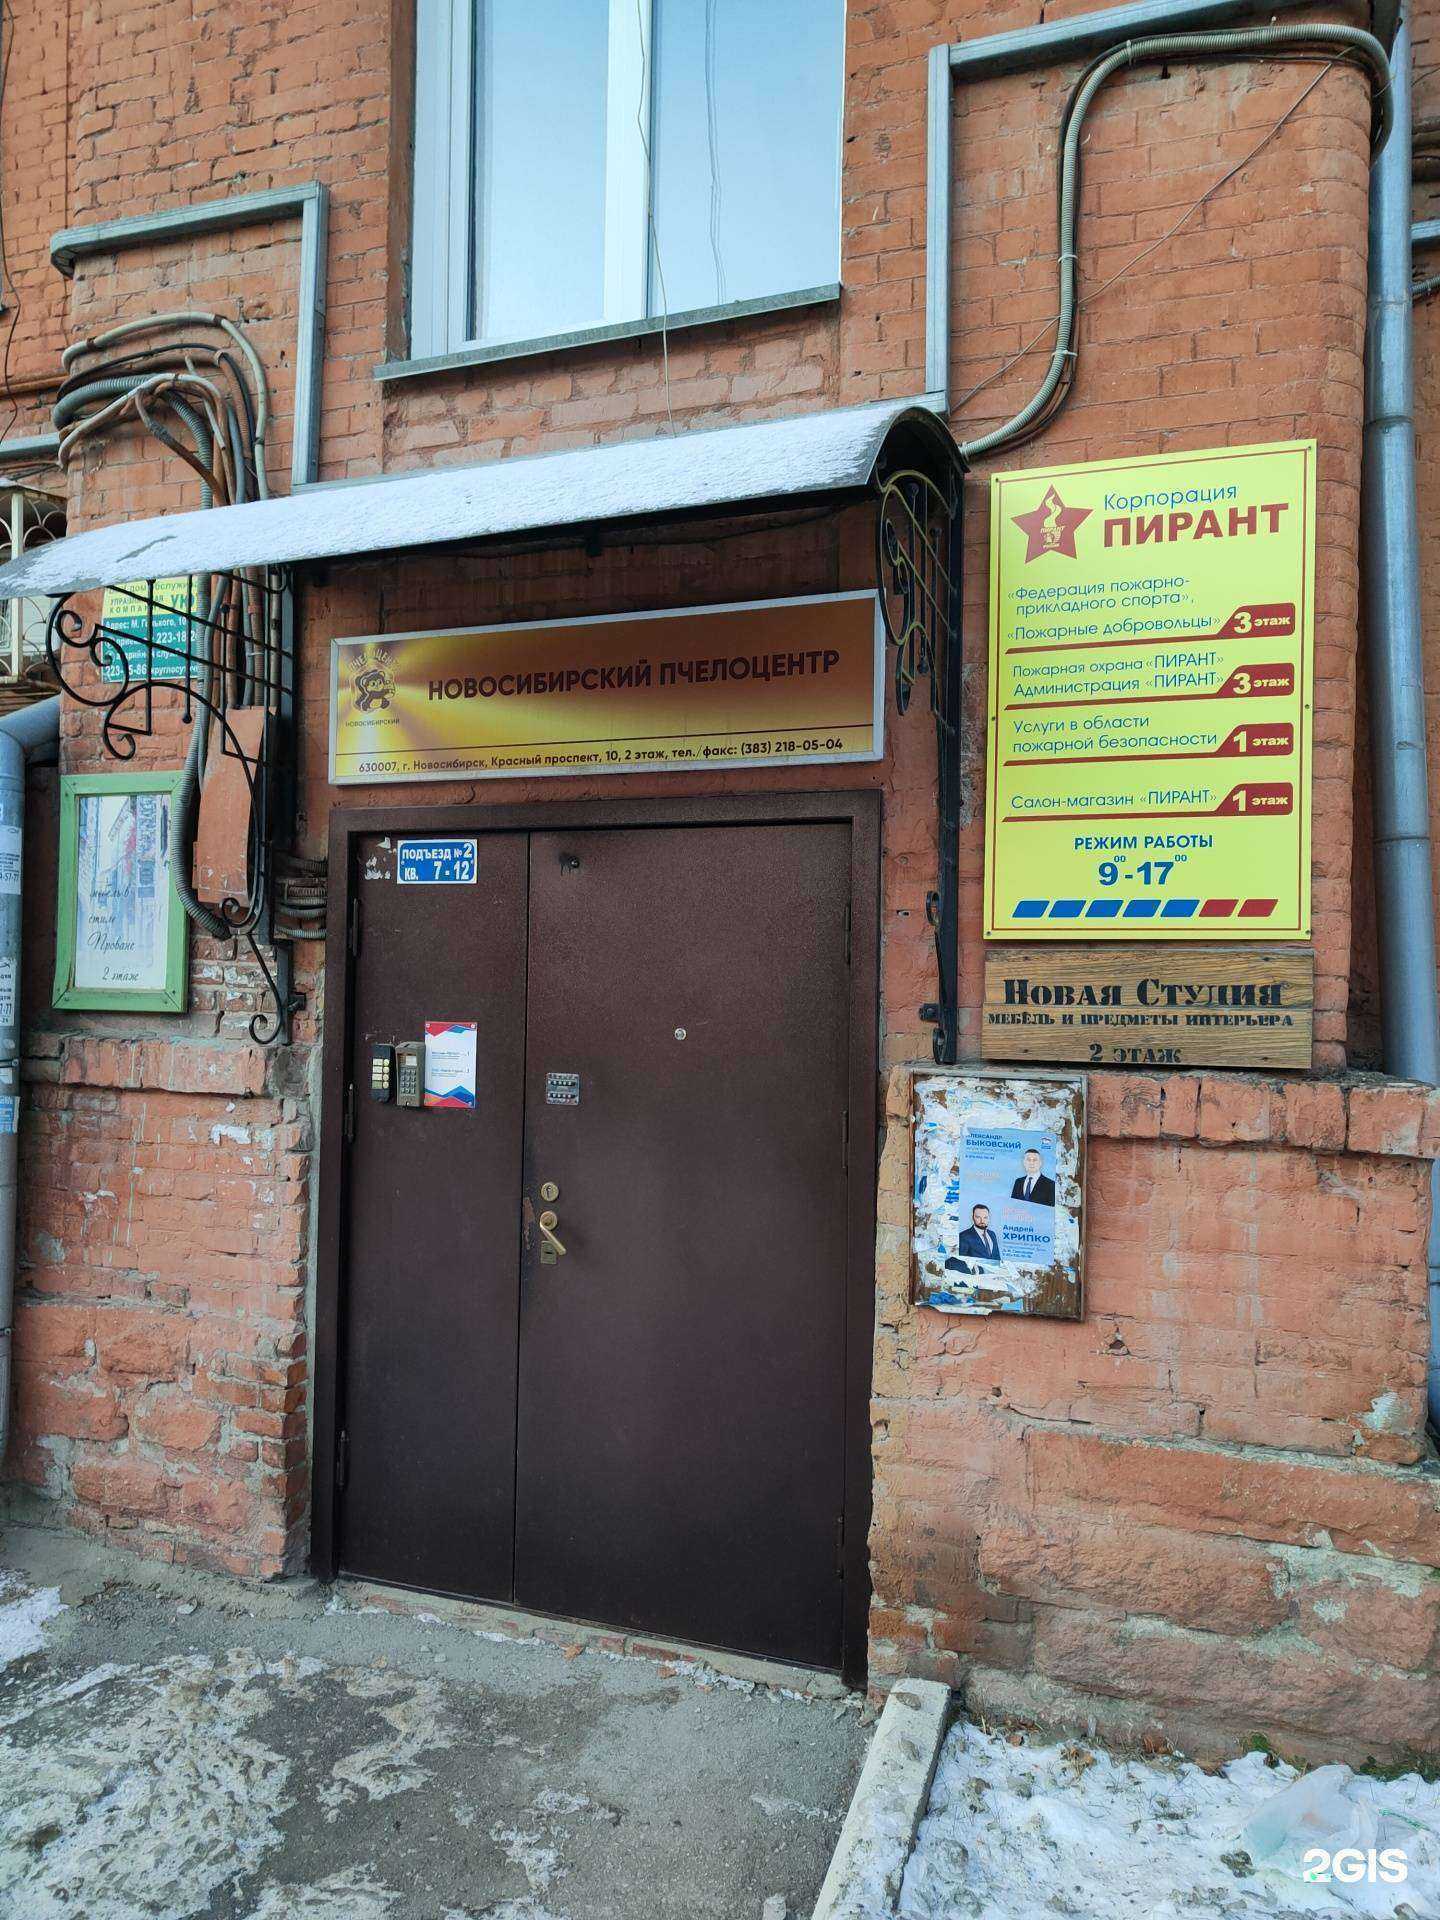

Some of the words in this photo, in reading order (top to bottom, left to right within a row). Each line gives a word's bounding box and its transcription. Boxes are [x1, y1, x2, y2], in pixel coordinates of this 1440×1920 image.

[1104, 486, 1237, 512] Корпорация
[1104, 503, 1289, 548] ПИРАНТ
[1008, 583, 1105, 601] «Федерация
[1110, 576, 1190, 595] пожарно-
[1016, 598, 1115, 618] прикладного
[1008, 624, 1098, 640] «Пожарные
[1103, 616, 1221, 635] добровольцы»
[1233, 611, 1252, 633] 3
[1254, 615, 1291, 627] этаж
[429, 660, 651, 701] НОВОСИБИРСКИЙ
[660, 649, 840, 685] ПЧЕЛОЦЕНТР
[1012, 663, 1085, 678] Пожарная
[1089, 660, 1142, 675] охрана
[1145, 651, 1224, 670] «ПИРАНТ»
[1013, 678, 1140, 697] Администрация
[1145, 672, 1224, 689] «ПИРАНТ»
[1232, 672, 1252, 694] 3
[1253, 677, 1290, 688] этаж
[1012, 719, 1065, 736] Услуги
[1070, 721, 1078, 730] в
[1083, 715, 1150, 730] области
[1013, 734, 1094, 754] пожарной
[1098, 732, 1218, 749] безопасности
[1233, 730, 1248, 753] 1
[1252, 736, 1289, 747] этаж
[359, 761, 400, 773] 630007,
[413, 759, 487, 770] Новосибирск,
[491, 754, 541, 768] Красный
[544, 752, 602, 765] проспект,
[605, 751, 621, 762] 10,
[624, 749, 632, 760] 2
[634, 750, 668, 760] этаж,
[740, 741, 771, 756] (383)
[775, 738, 843, 752] 218-05-04
[1011, 792, 1134, 809] Салон-магазин
[1139, 789, 1218, 805] «ПИРАНТ»
[1232, 790, 1247, 812] 1
[1252, 795, 1289, 806] этаж
[1074, 835, 1137, 850] РЕЖИМ
[1144, 834, 1213, 849] РАБОТЫ
[402, 848, 452, 861] ПОДЪЕЗД
[102, 966, 110, 980] 2
[988, 1012, 1055, 1026] МЕБЕЛЬ
[1062, 1013, 1073, 1025] И
[1081, 1013, 1178, 1028] ПРЕДМЕТЫ
[1186, 1014, 1294, 1027] ИНТЕРЬЕРА
[1090, 1043, 1103, 1063] 2
[1113, 1048, 1182, 1063] ЭТАЖ
[966, 1139, 1022, 1149] БЫКОВСКИЙ
[1003, 1224, 1034, 1233] Андрей
[1003, 1232, 1051, 1243] ХРИПКО
